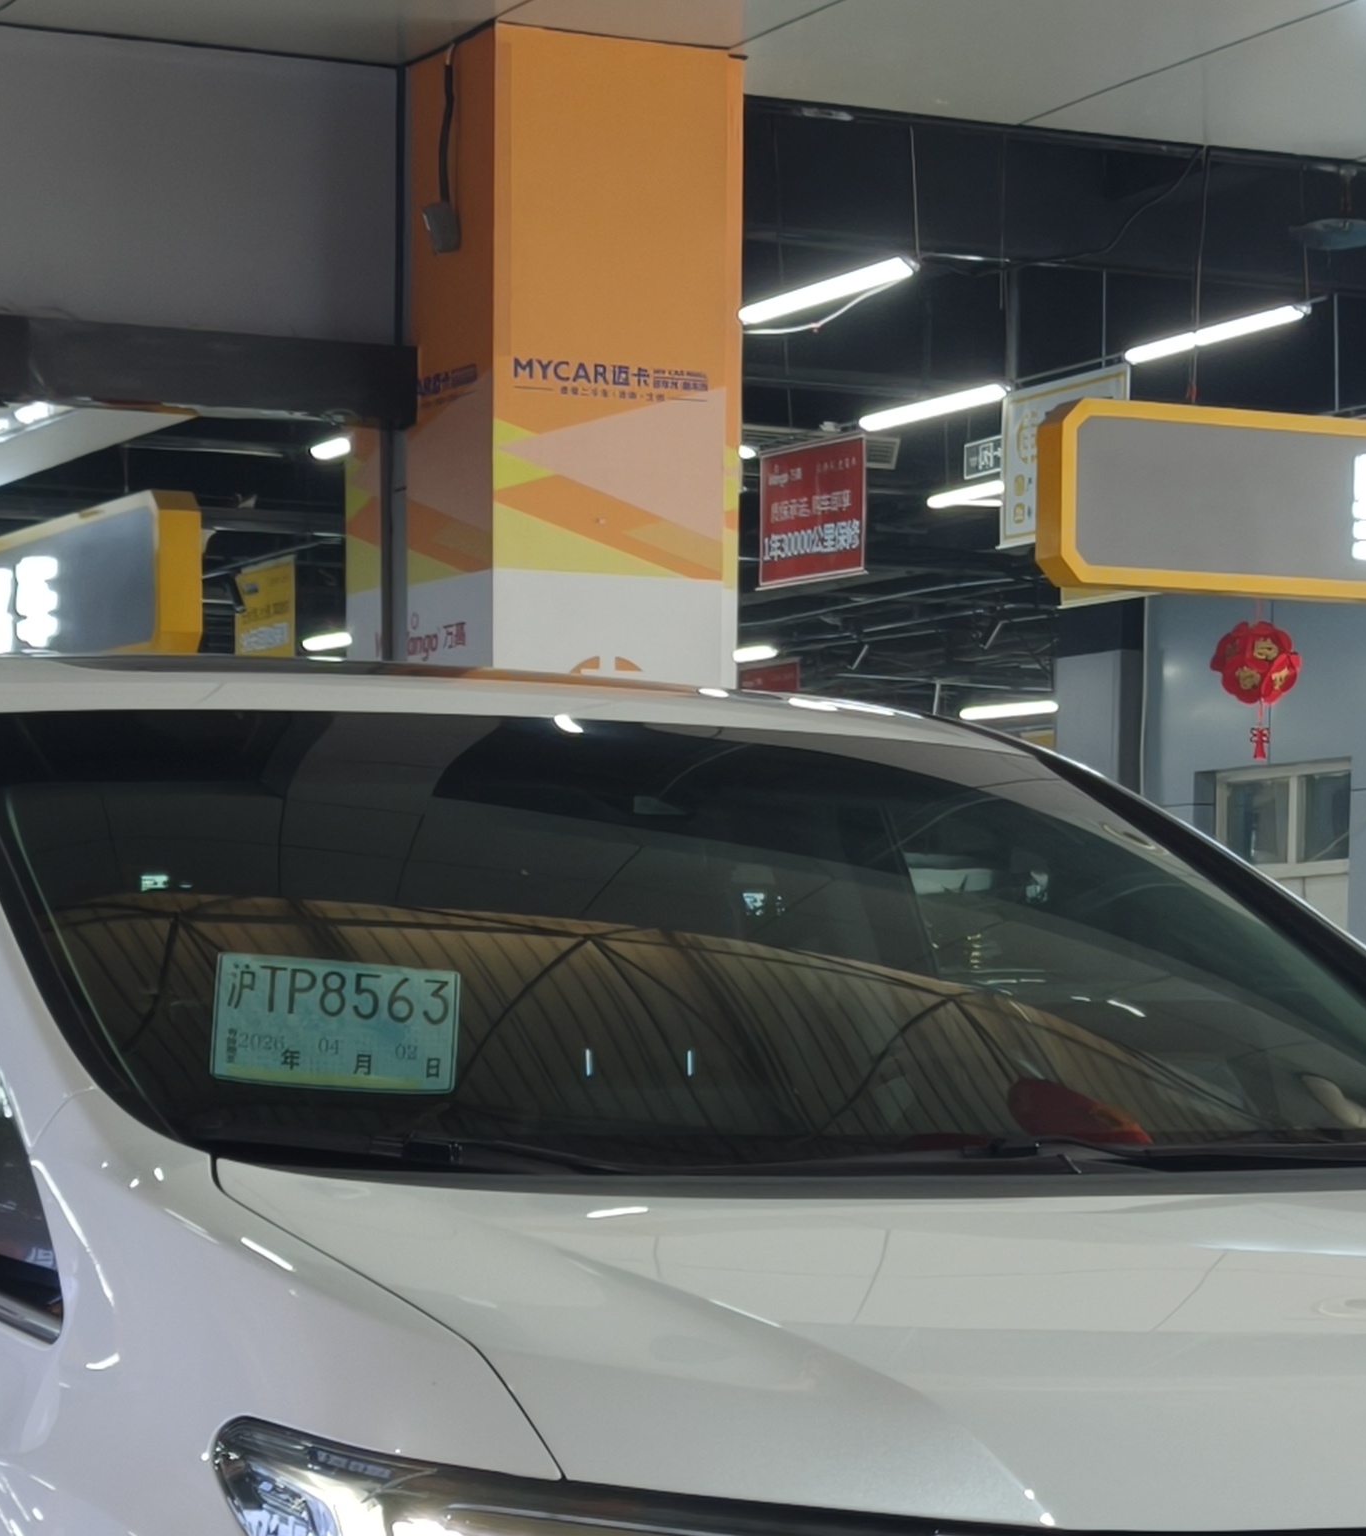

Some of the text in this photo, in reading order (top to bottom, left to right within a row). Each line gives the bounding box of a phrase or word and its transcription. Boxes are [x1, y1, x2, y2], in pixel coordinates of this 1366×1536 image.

[226, 962, 449, 1025] 沪TP8563
[281, 1049, 301, 1071] 年
[353, 1054, 373, 1076] 月
[425, 1057, 441, 1079] 日
